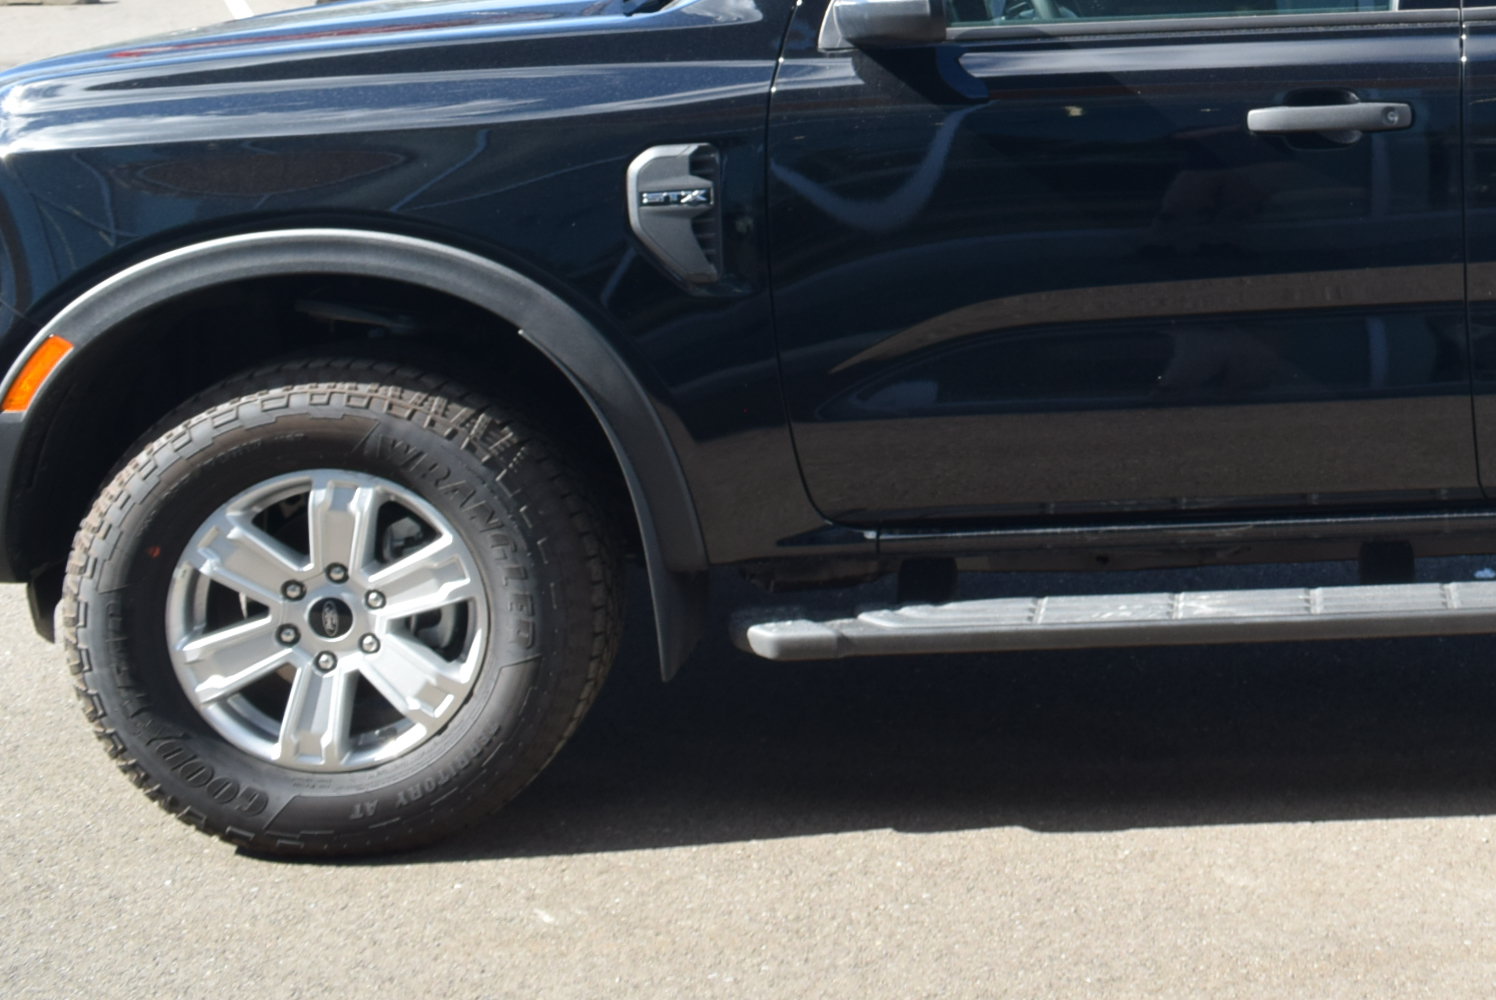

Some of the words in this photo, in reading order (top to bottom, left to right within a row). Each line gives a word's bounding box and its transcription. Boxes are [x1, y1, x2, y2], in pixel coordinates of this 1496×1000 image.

[642, 189, 708, 204] STX
[377, 435, 537, 650] WRANGLER
[103, 602, 270, 818] GOODYEAR
